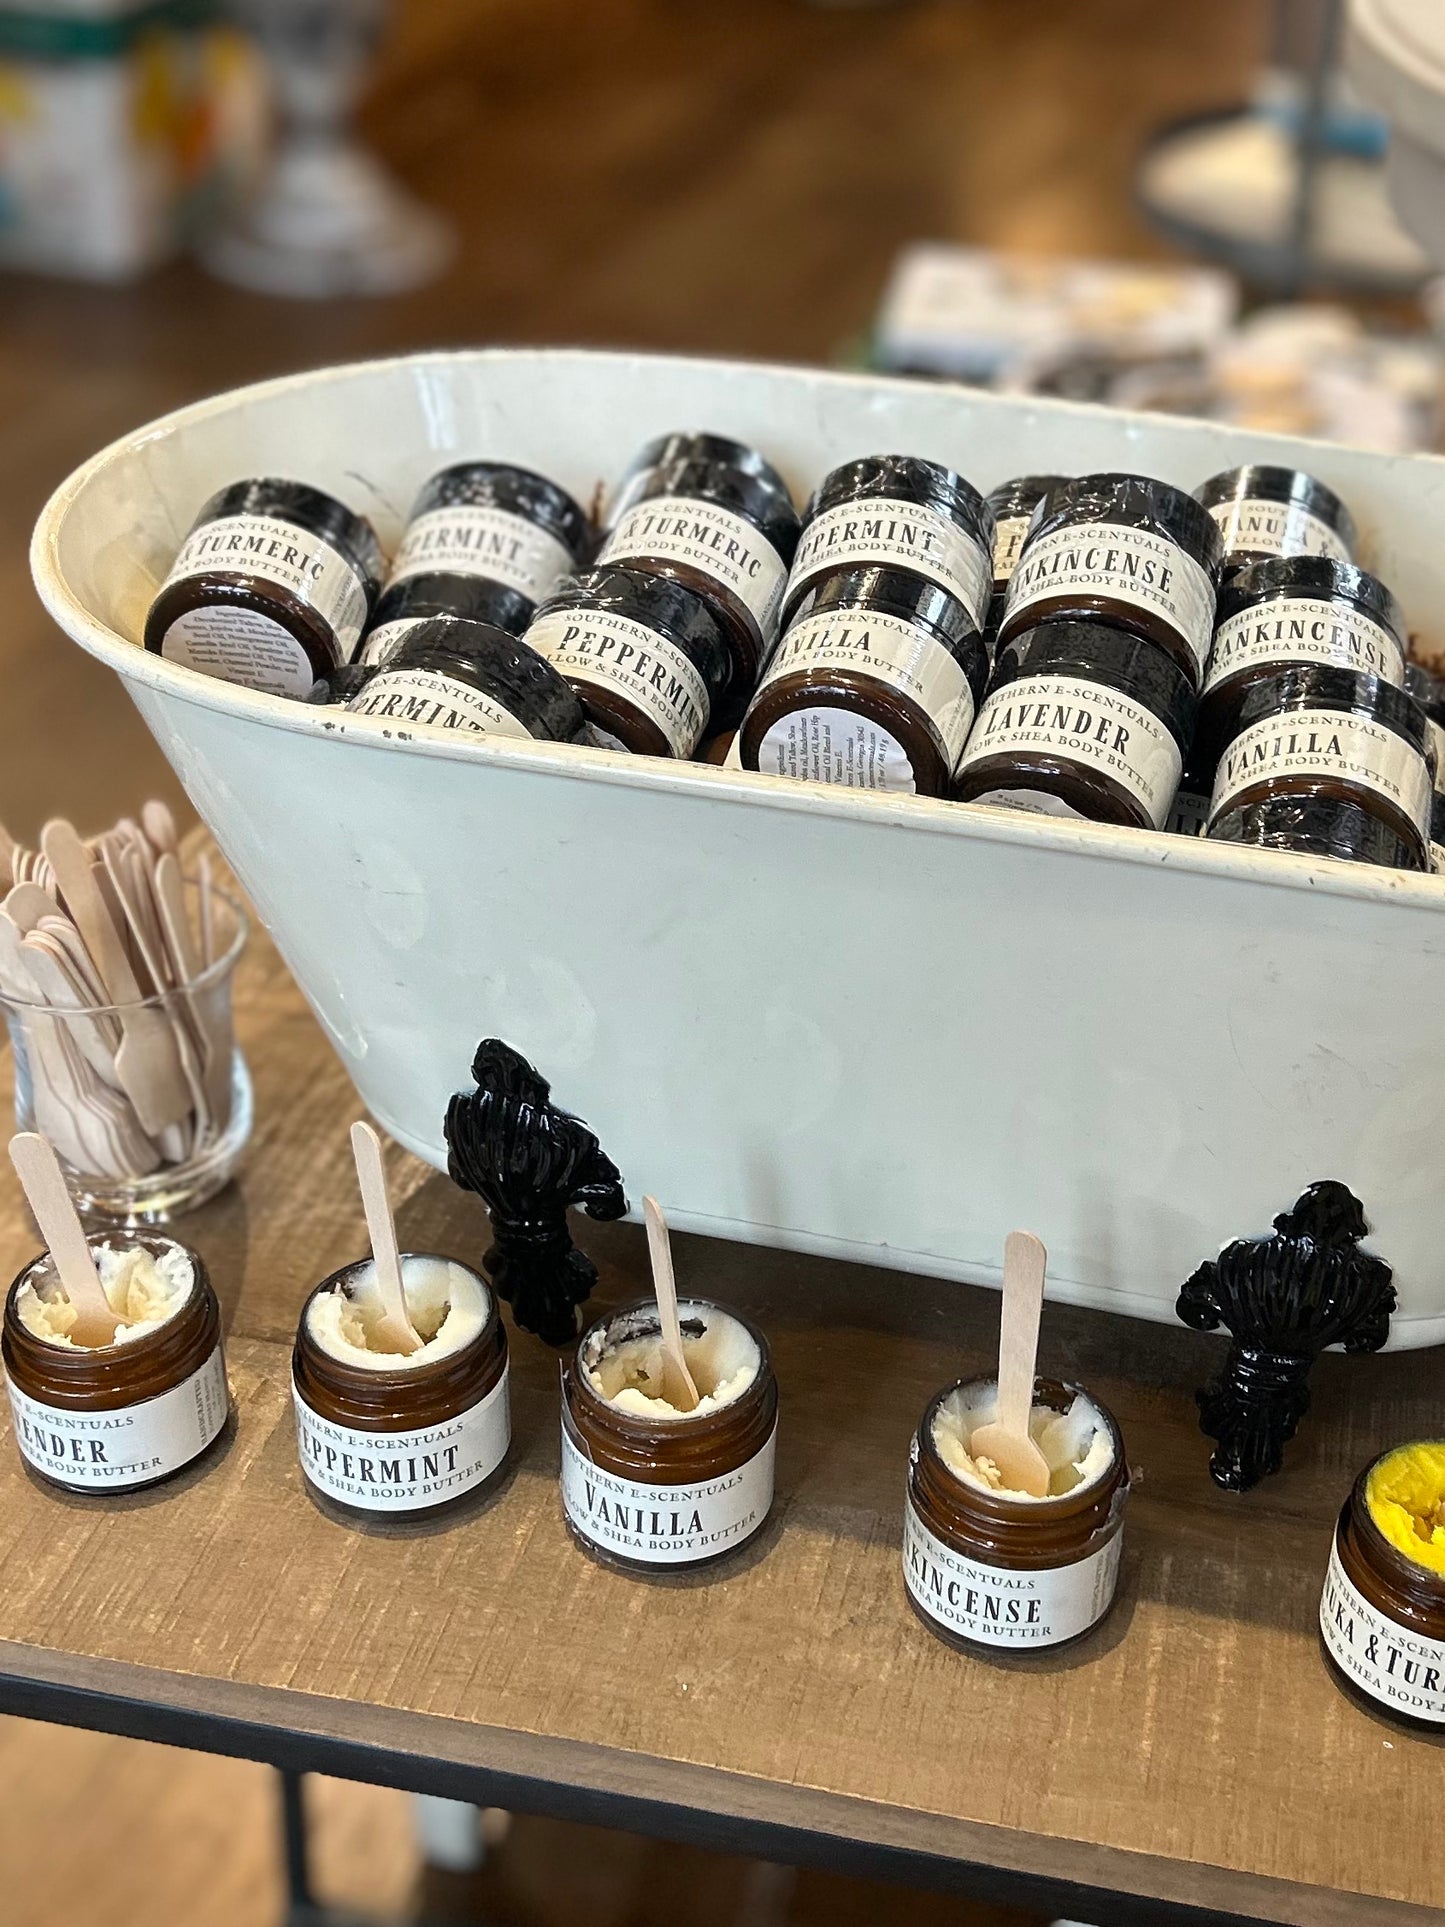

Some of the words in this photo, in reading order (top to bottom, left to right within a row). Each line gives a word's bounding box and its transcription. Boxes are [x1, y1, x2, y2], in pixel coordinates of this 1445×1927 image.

[197, 534, 325, 581] TURMERIC
[641, 514, 762, 578] TURMERIC
[849, 541, 894, 552] BODY
[1062, 529, 1171, 558] E-SCENTUALS
[682, 546, 740, 585] BUTTER
[1069, 574, 1114, 585] BODY
[1119, 578, 1177, 615] BUTTER
[564, 613, 653, 643] SOUTHERN
[1282, 603, 1386, 645] E-SCENTUALS
[1250, 642, 1292, 655] SHEA
[392, 676, 504, 724] E-SCENTUALS
[595, 663, 606, 673] &
[610, 668, 647, 696] SHEA
[650, 694, 680, 729] BODY
[1053, 685, 1160, 740] E-SCENTUALS
[984, 703, 1131, 756] LAVENDER
[1270, 716, 1388, 744] E-SCENTUALS
[997, 734, 1006, 744] &
[1011, 731, 1053, 743] SHEA
[1058, 735, 1104, 759] BODY
[1107, 753, 1156, 802] BUTTER
[1225, 732, 1343, 782] VANILLA
[1284, 756, 1333, 767] BODY
[1338, 760, 1402, 798] BUTTER
[347, 1422, 464, 1450] E-SCENTUALS
[46, 1458, 88, 1477] BODY
[93, 1456, 163, 1478] BUTTER
[328, 1475, 367, 1497] SHEA
[371, 1487, 417, 1499] BODY
[422, 1460, 484, 1495] BUTTER
[630, 1473, 744, 1502] E-SCENTUALS
[584, 1479, 705, 1536] VANILLA
[591, 1519, 600, 1531] &
[603, 1525, 643, 1549] SHEA
[648, 1538, 695, 1551] BODY
[700, 1510, 758, 1546] BUTTER
[926, 1539, 1036, 1590] E-SCENTUALS
[935, 1600, 977, 1629] BODY
[982, 1623, 1053, 1638] BUTTER
[1346, 1655, 1383, 1690] SHEA
[1387, 1683, 1437, 1711] BODY
[1364, 1633, 1379, 1667] &
[1384, 1645, 1445, 1693] TUR
